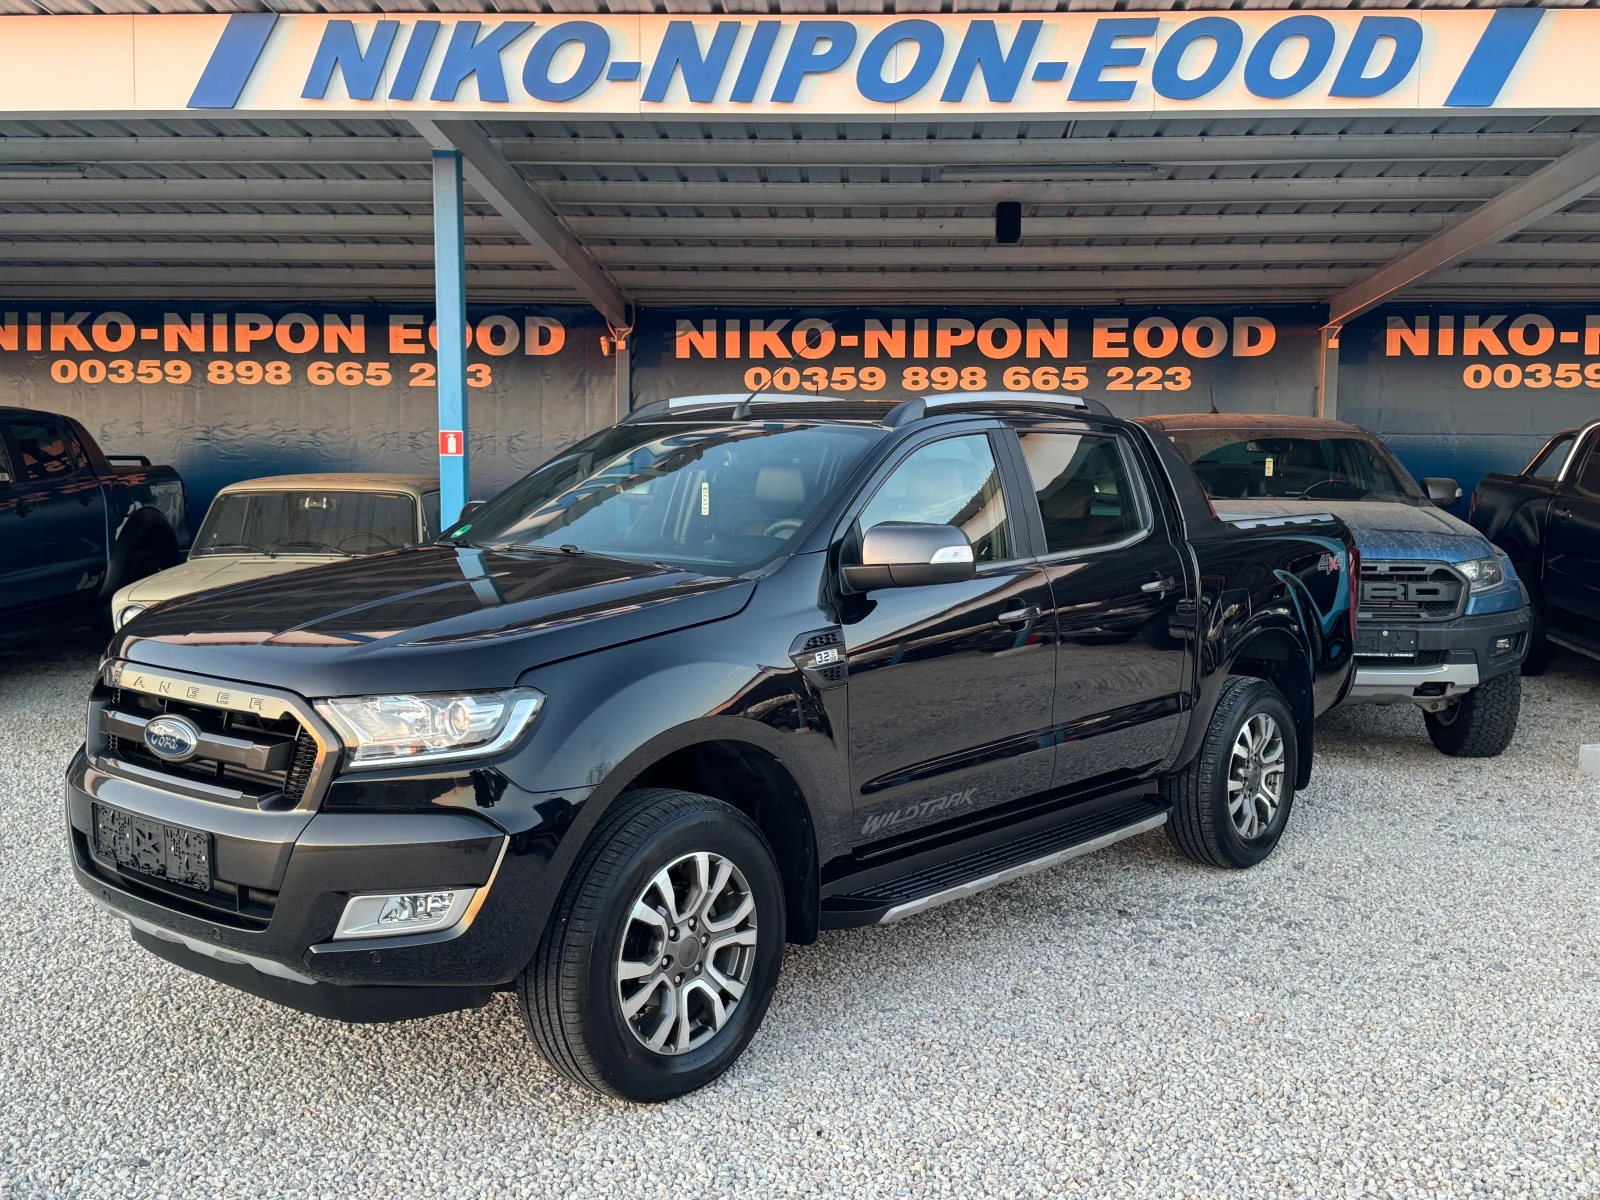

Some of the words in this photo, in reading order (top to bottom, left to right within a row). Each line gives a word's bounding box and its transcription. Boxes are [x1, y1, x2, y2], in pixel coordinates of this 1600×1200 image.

[301, 16, 1423, 103] NIKO-NIPON-EOOD
[676, 317, 1068, 360] NIKO-NIPON
[1092, 316, 1276, 359] EOOD
[51, 359, 192, 384] 00359
[207, 360, 292, 385] 898
[307, 361, 392, 386] 665
[409, 362, 493, 388] 23
[744, 366, 886, 391] 00359
[901, 366, 987, 391] 898
[1003, 366, 1089, 391] 665
[1106, 366, 1192, 391] 223
[1463, 363, 1600, 389] 00359
[861, 787, 978, 835] WILDTRAK
